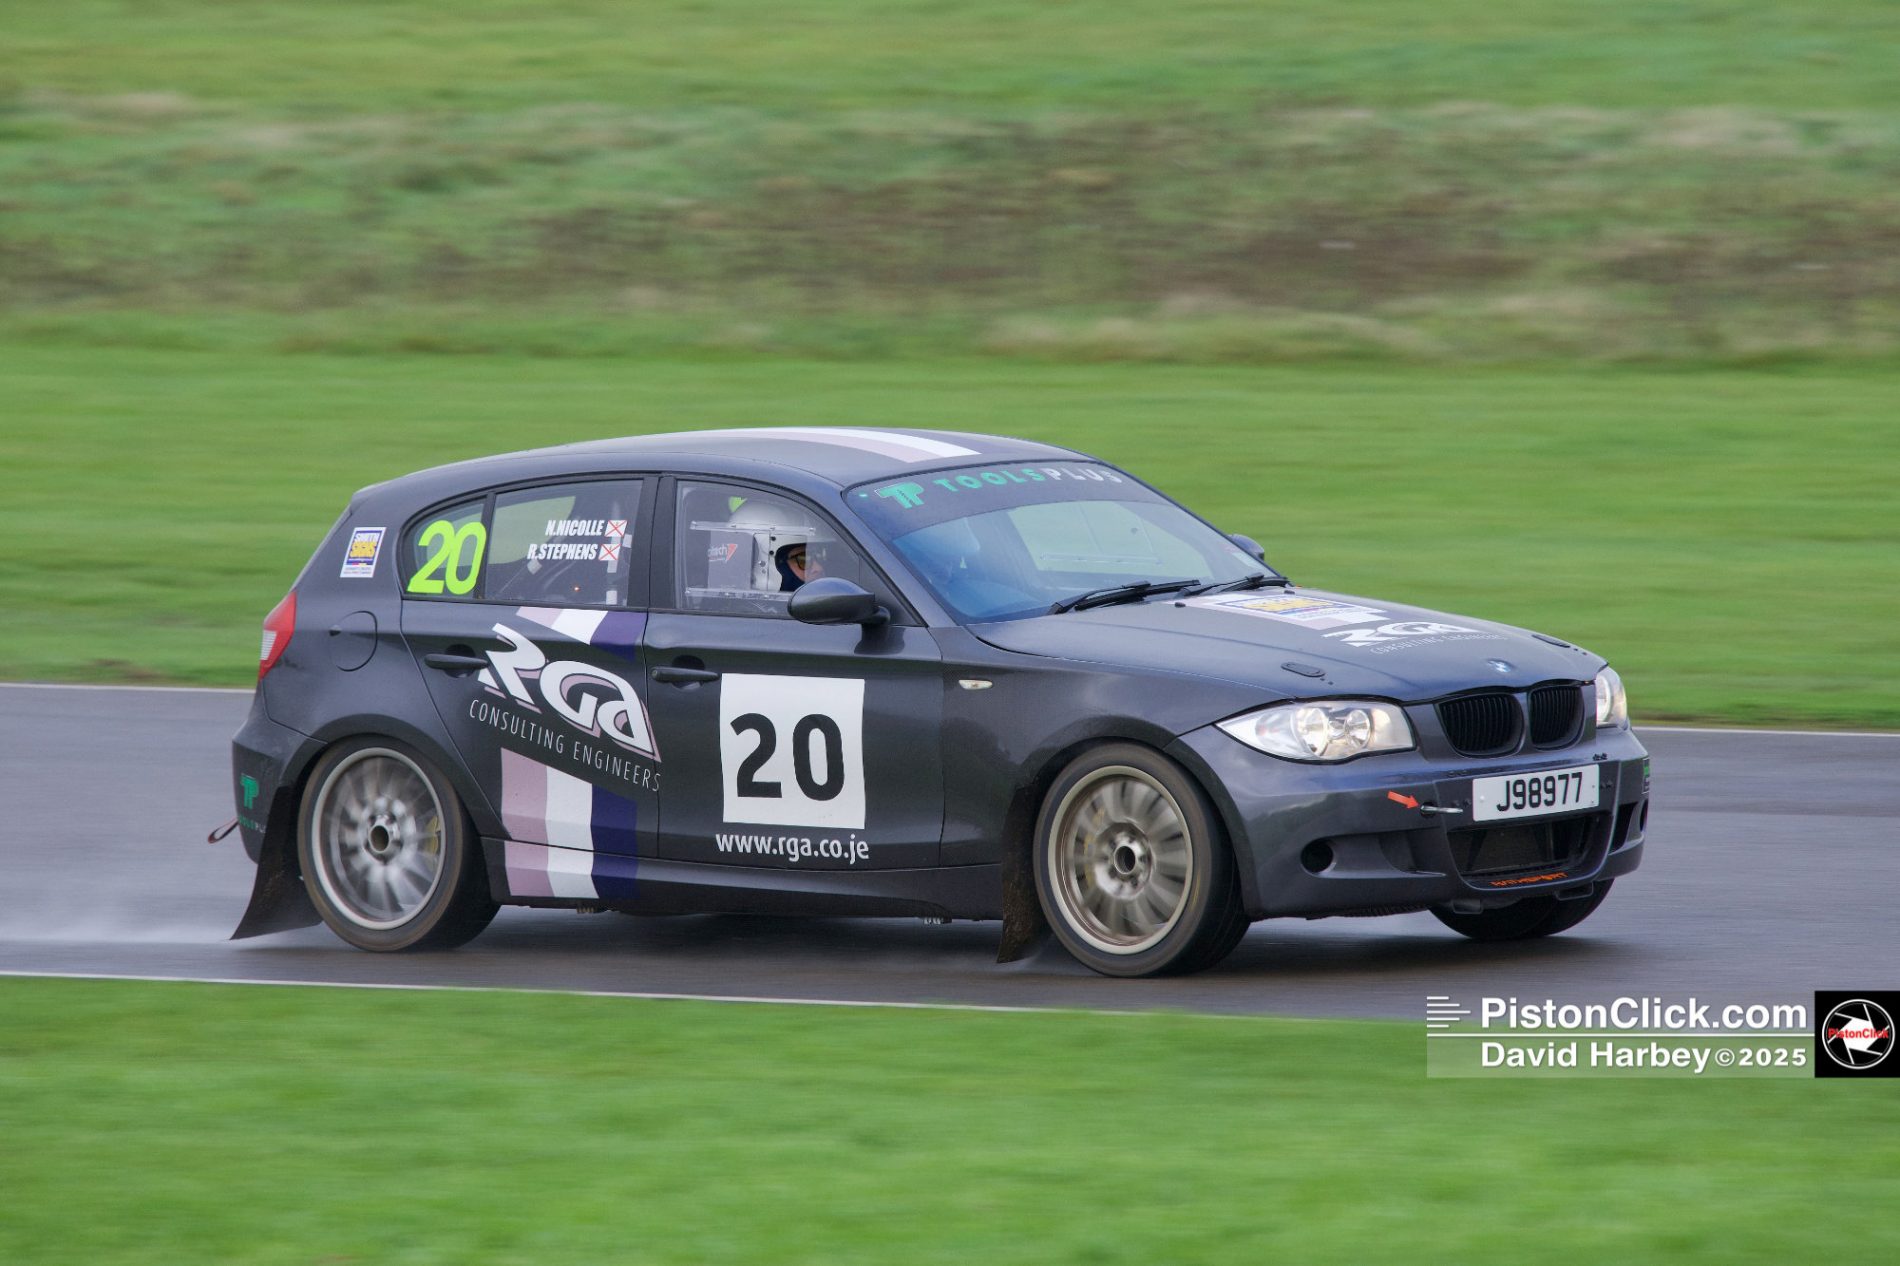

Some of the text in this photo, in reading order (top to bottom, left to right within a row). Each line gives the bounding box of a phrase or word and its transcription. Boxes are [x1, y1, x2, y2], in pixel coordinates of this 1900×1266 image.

[407, 519, 487, 595] 20
[527, 543, 599, 560] R.STEPHENS
[469, 699, 661, 792] CONSULTING ENGINEERS
[730, 712, 845, 801] 20
[1496, 772, 1582, 812] J98977
[715, 833, 870, 865] www.rga.co.je
